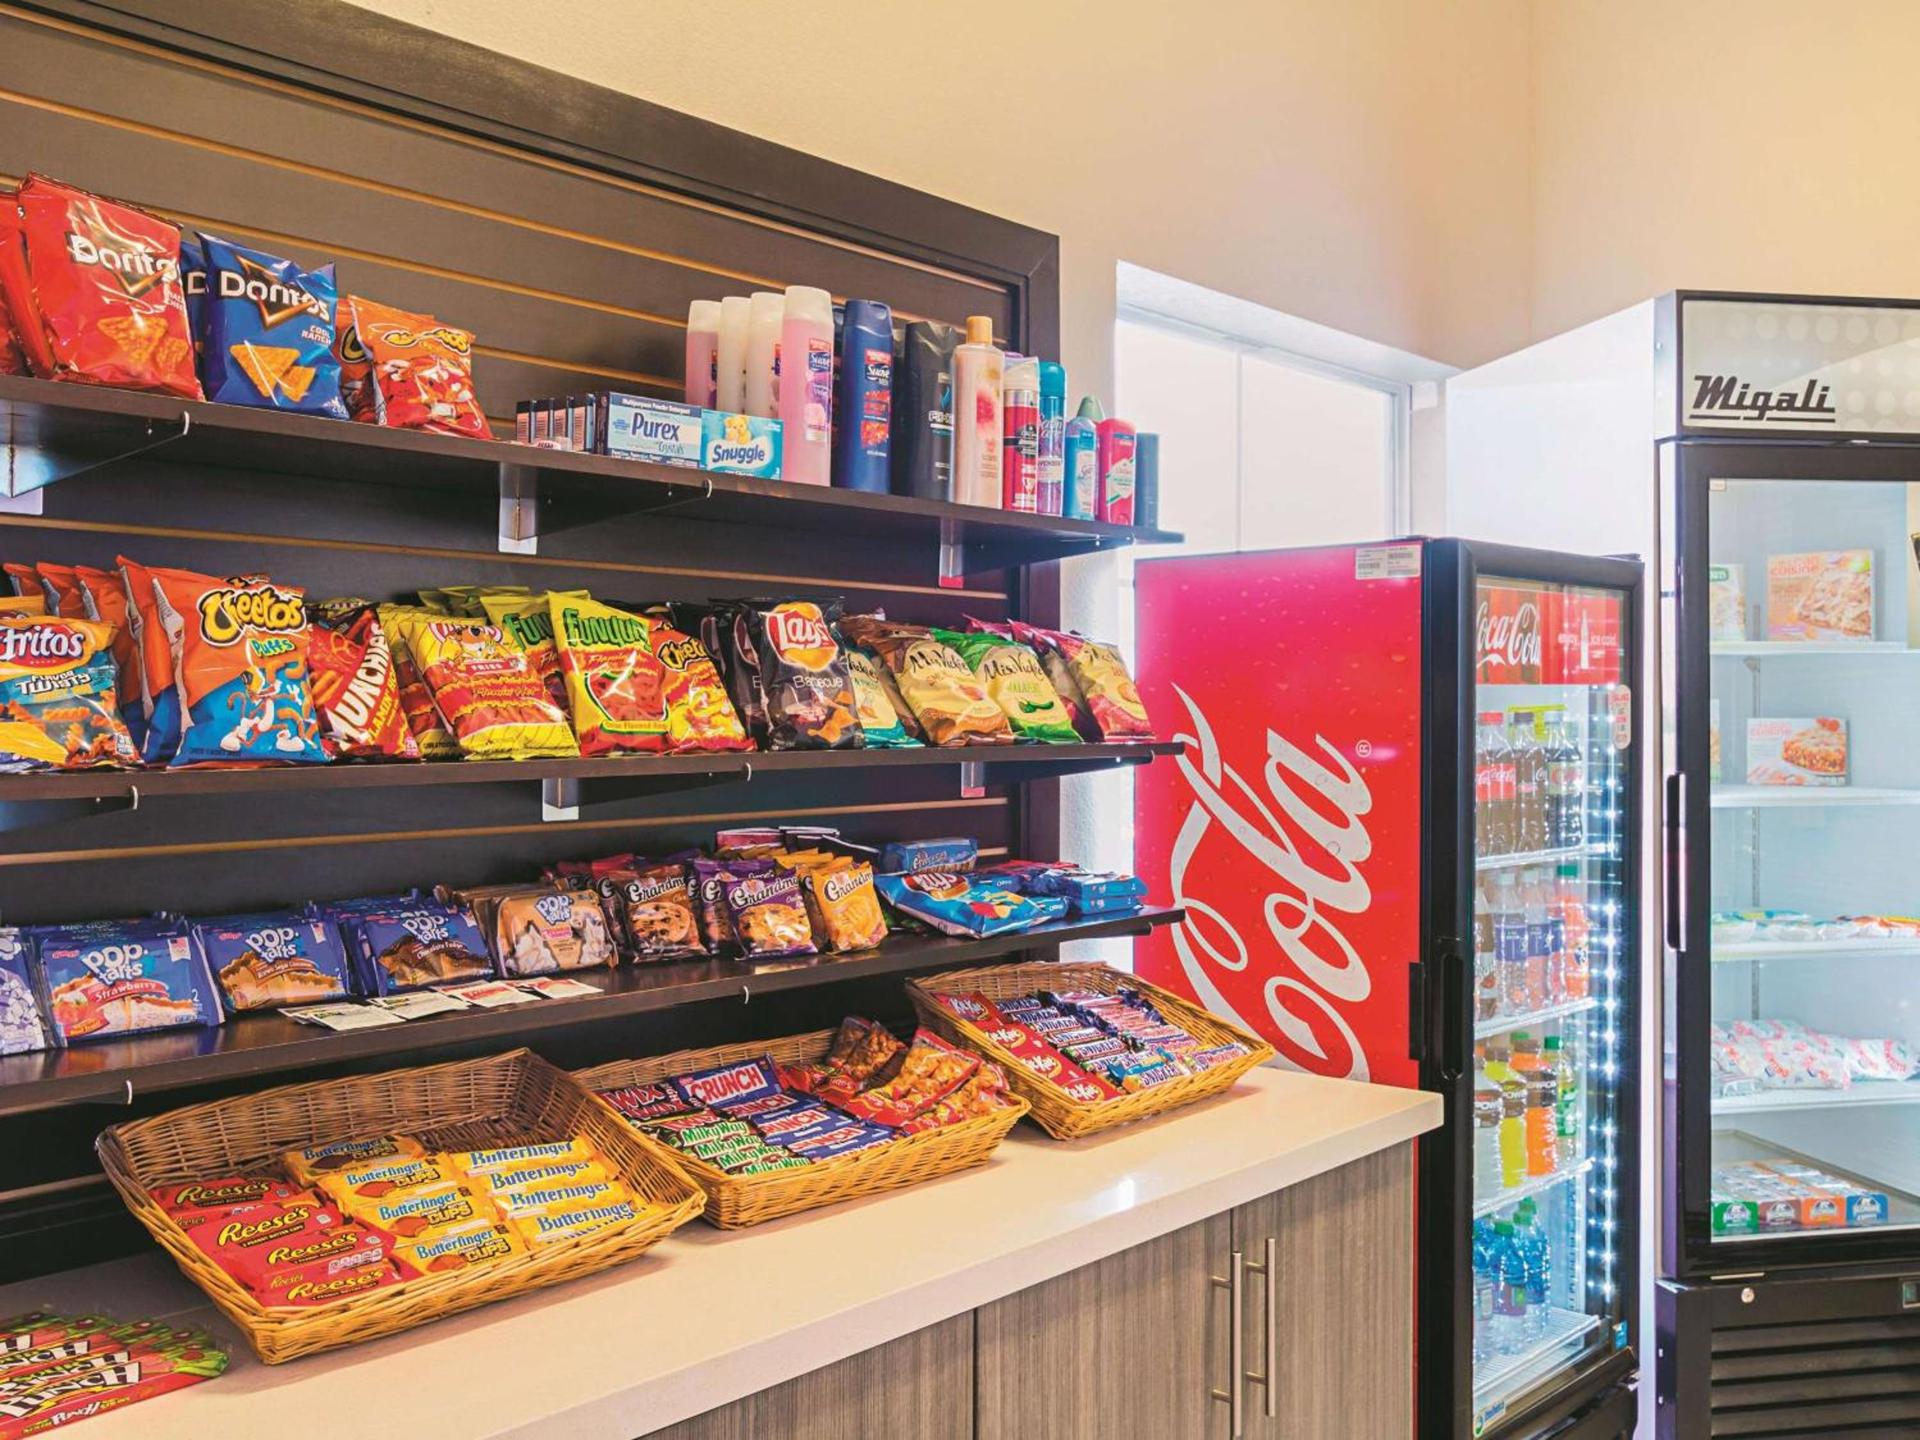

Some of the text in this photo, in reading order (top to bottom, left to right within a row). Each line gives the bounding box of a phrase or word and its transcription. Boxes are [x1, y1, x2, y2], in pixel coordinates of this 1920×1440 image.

[220, 271, 332, 322] Doritos
[1693, 376, 1835, 420] Migali
[632, 412, 681, 441] Purex
[713, 444, 765, 467] Snuggle
[199, 587, 306, 647] Cheetos
[252, 639, 296, 657] Puffs
[260, 944, 297, 963] tarts
[100, 963, 143, 985] tarts
[96, 982, 157, 1001] Strawberry
[691, 1066, 763, 1102] CRUNCH
[304, 1138, 384, 1165] Butterfinger
[471, 1141, 573, 1168] Butterfinger
[346, 1161, 423, 1186] Butterfinger
[393, 1168, 441, 1189] CUPS
[176, 1180, 270, 1205] Reese's
[379, 1191, 457, 1221] Butterfinger
[218, 1207, 311, 1247] Reese's
[427, 1202, 474, 1225] CUPS
[268, 1232, 358, 1264] Reese's
[416, 1230, 495, 1262] Butterfinger
[465, 1238, 511, 1263] CUPS
[288, 1269, 385, 1300] Reese's
